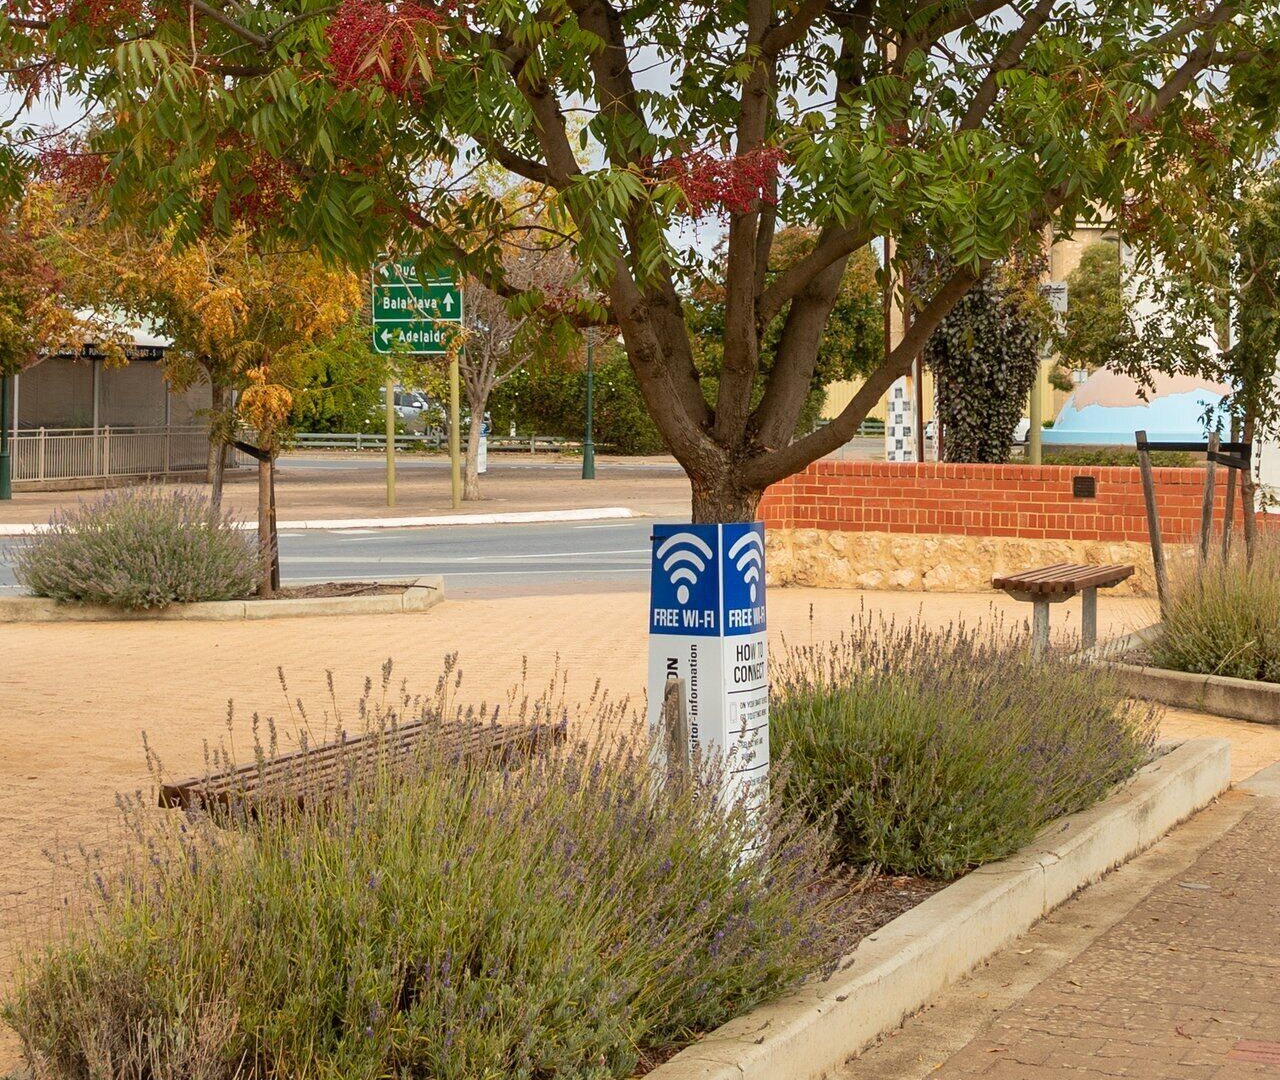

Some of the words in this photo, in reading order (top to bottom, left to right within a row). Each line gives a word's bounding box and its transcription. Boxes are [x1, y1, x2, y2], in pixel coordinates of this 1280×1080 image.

[383, 297, 438, 309] Balaklava
[654, 608, 680, 627] FREE
[683, 609, 715, 628] WI-FI
[728, 608, 753, 628] FREE
[736, 643, 756, 662] HOW
[757, 641, 764, 659] TO
[733, 661, 765, 684] CONNECT
